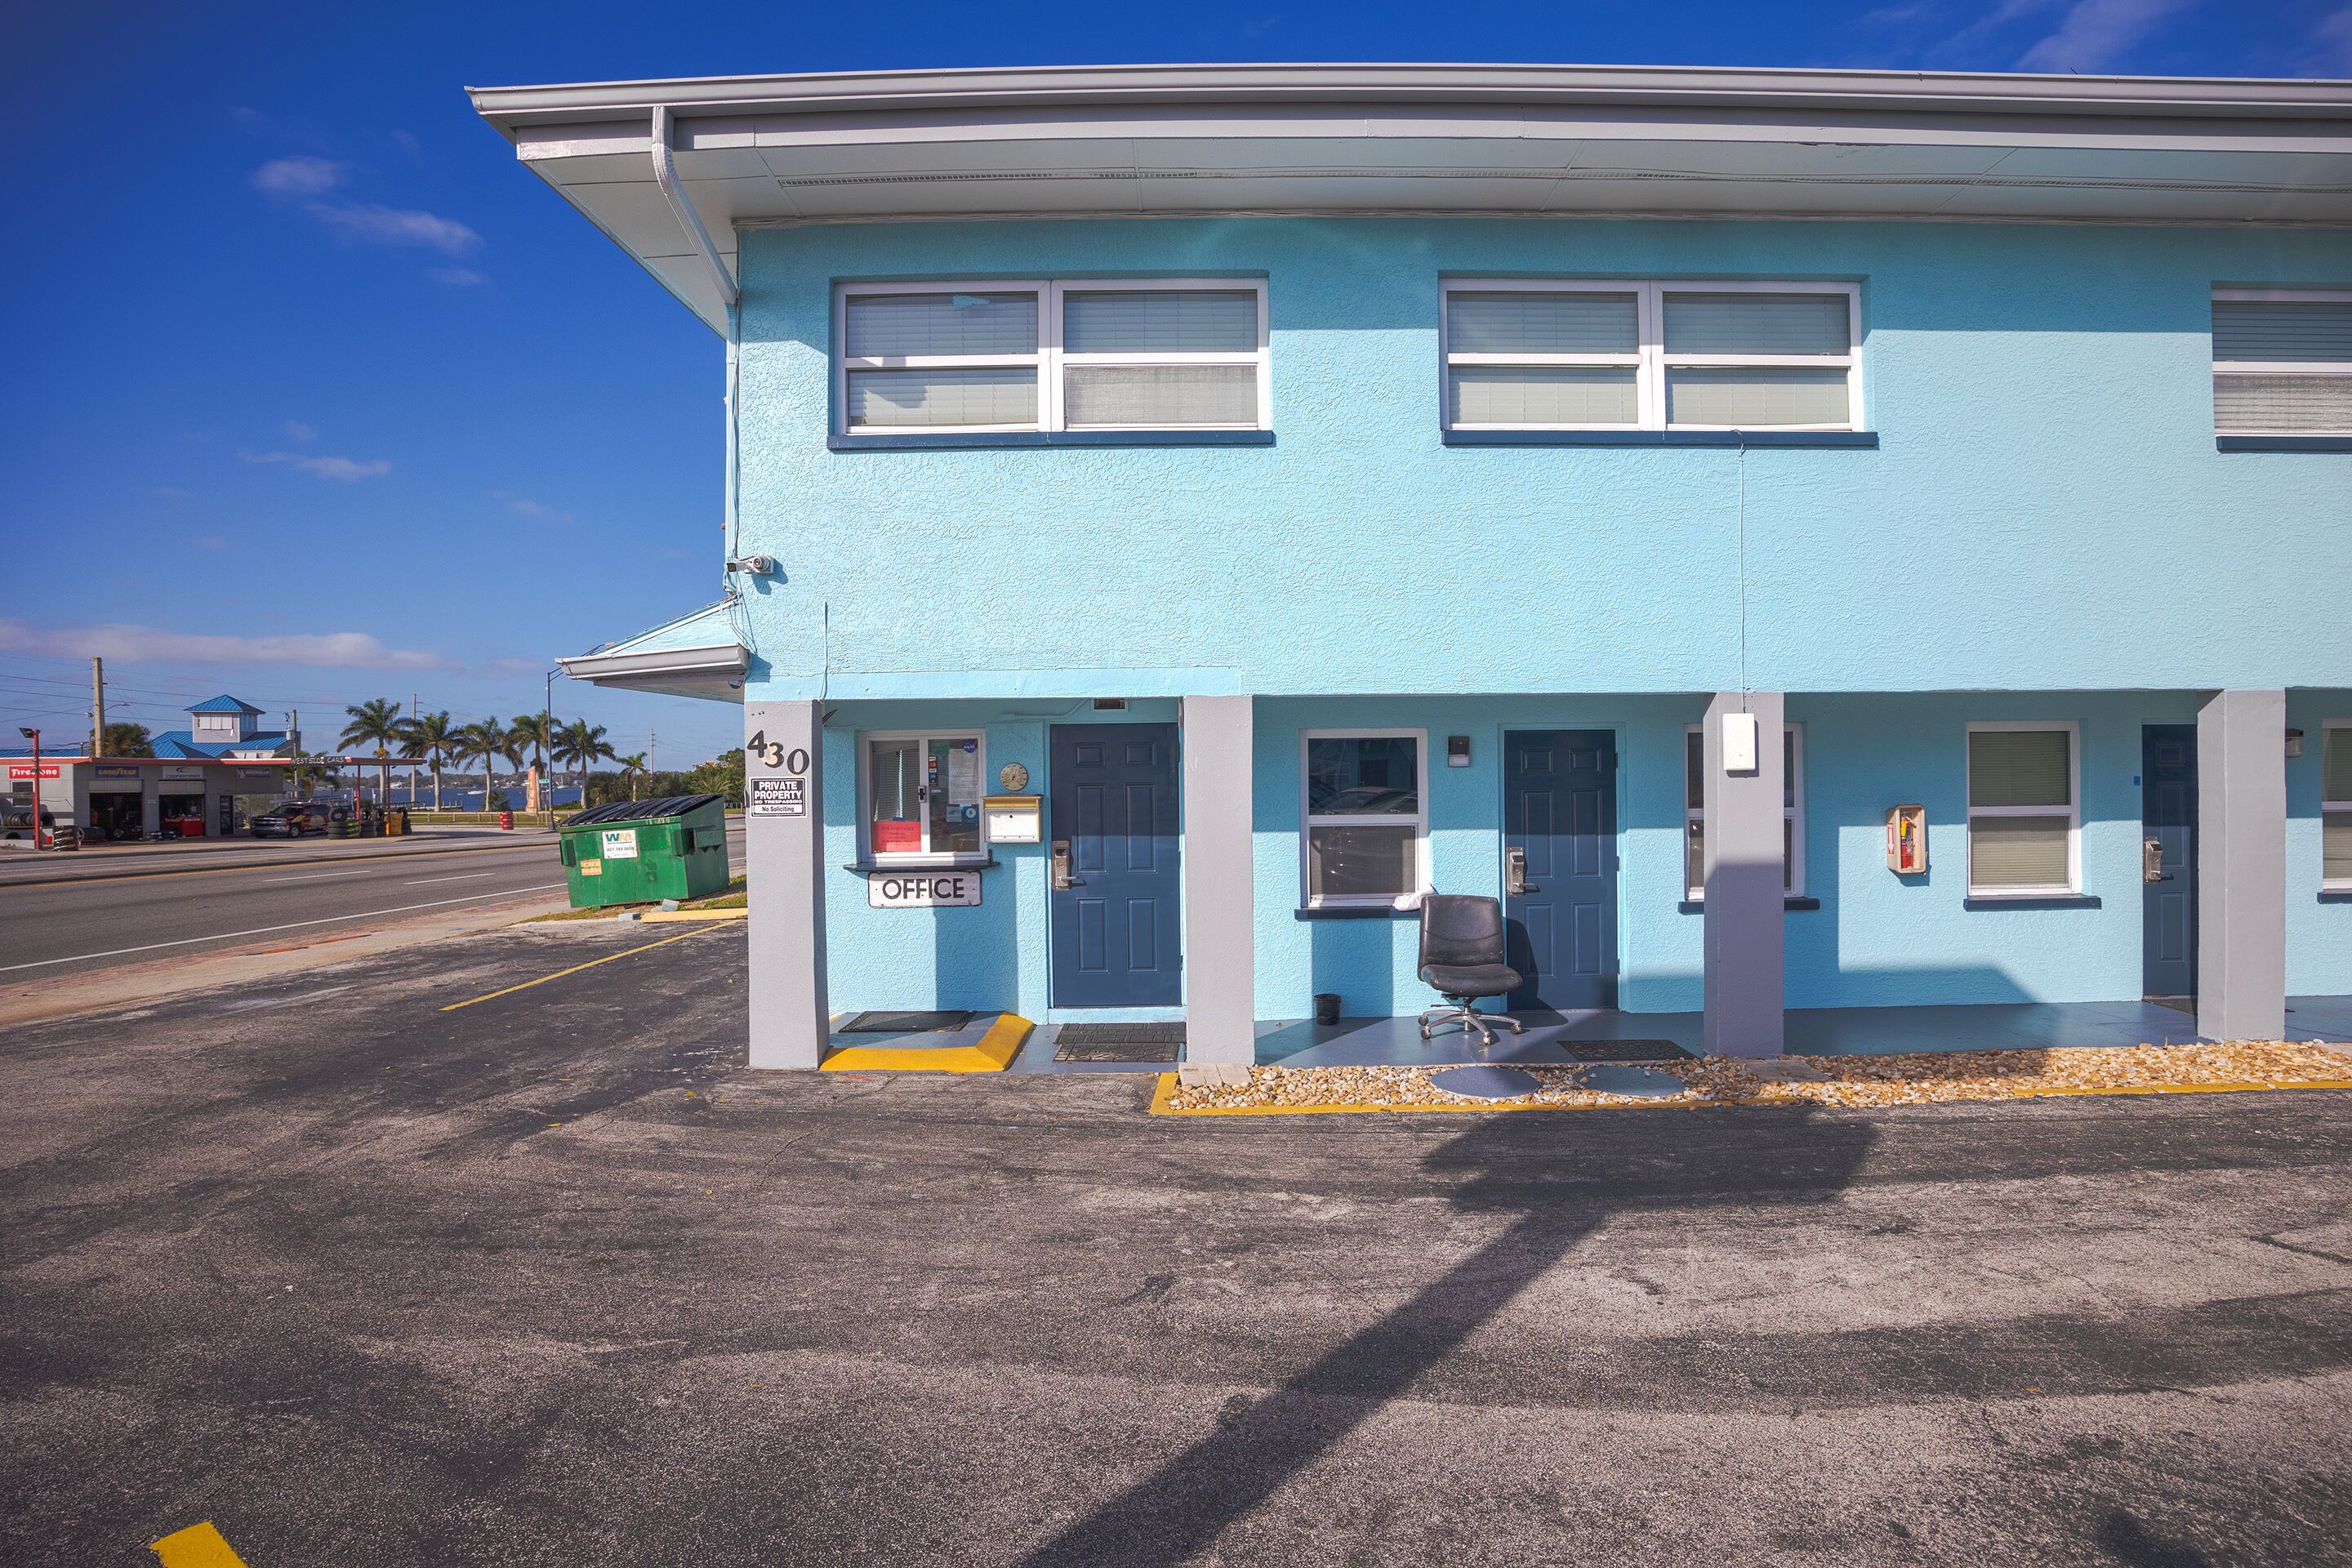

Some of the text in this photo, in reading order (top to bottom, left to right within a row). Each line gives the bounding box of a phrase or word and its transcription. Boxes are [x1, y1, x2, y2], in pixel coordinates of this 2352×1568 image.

[746, 729, 810, 775] 430
[292, 756, 324, 764] WESTSIDE
[11, 768, 57, 777] Fireone
[759, 782, 797, 791] PRIVATE
[754, 791, 802, 800] PROPERTY
[883, 878, 964, 899] OFFICE
